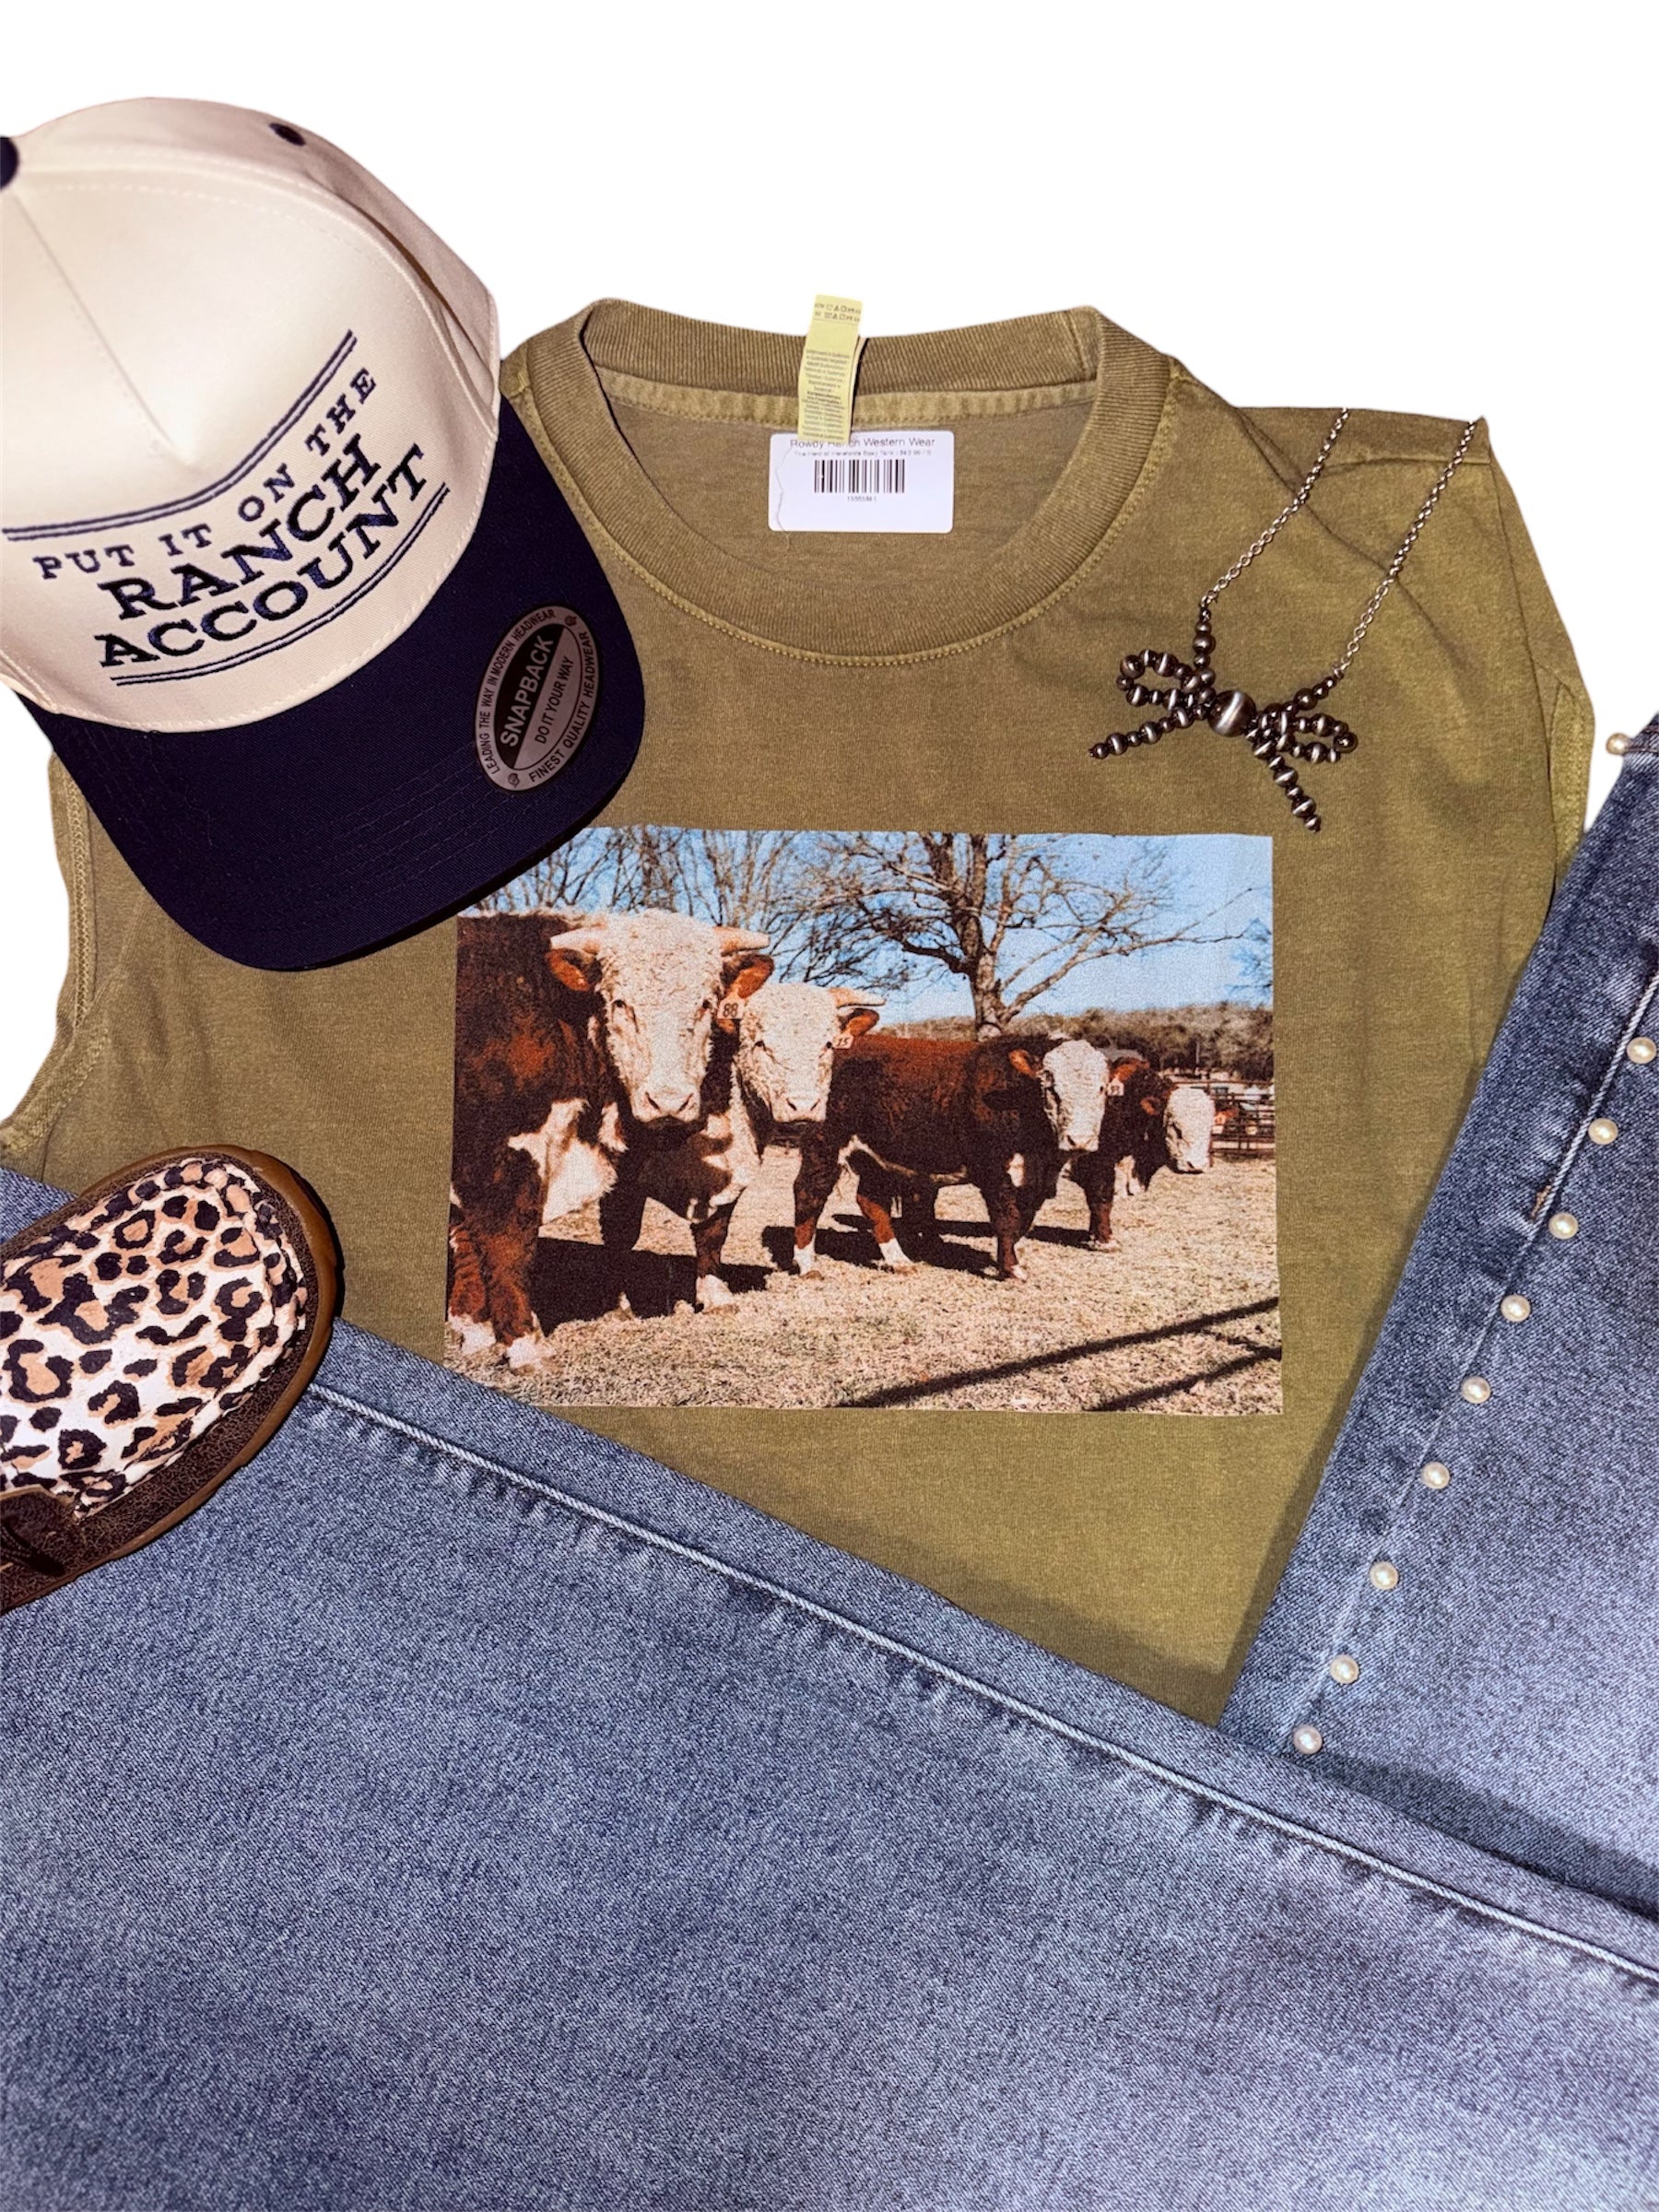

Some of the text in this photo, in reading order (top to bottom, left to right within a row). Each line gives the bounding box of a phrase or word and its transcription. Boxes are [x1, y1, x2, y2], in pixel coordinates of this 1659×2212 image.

[33, 369, 376, 579] PUT IT ON THE
[790, 439, 824, 450] Rowdy
[864, 437, 905, 447] Western
[910, 437, 935, 447] Wear
[95, 443, 428, 667] ACCOUNT
[97, 433, 382, 620] RANCH
[478, 608, 557, 774] LEADING THE WAY IN MODERN HEADWEAR
[500, 634, 554, 747] SNAPBACK
[528, 631, 595, 783] FINEST QUALITY HEADWEAR
[535, 655, 575, 745] DO IT YOUR WAY
[723, 1003, 738, 1018] 88
